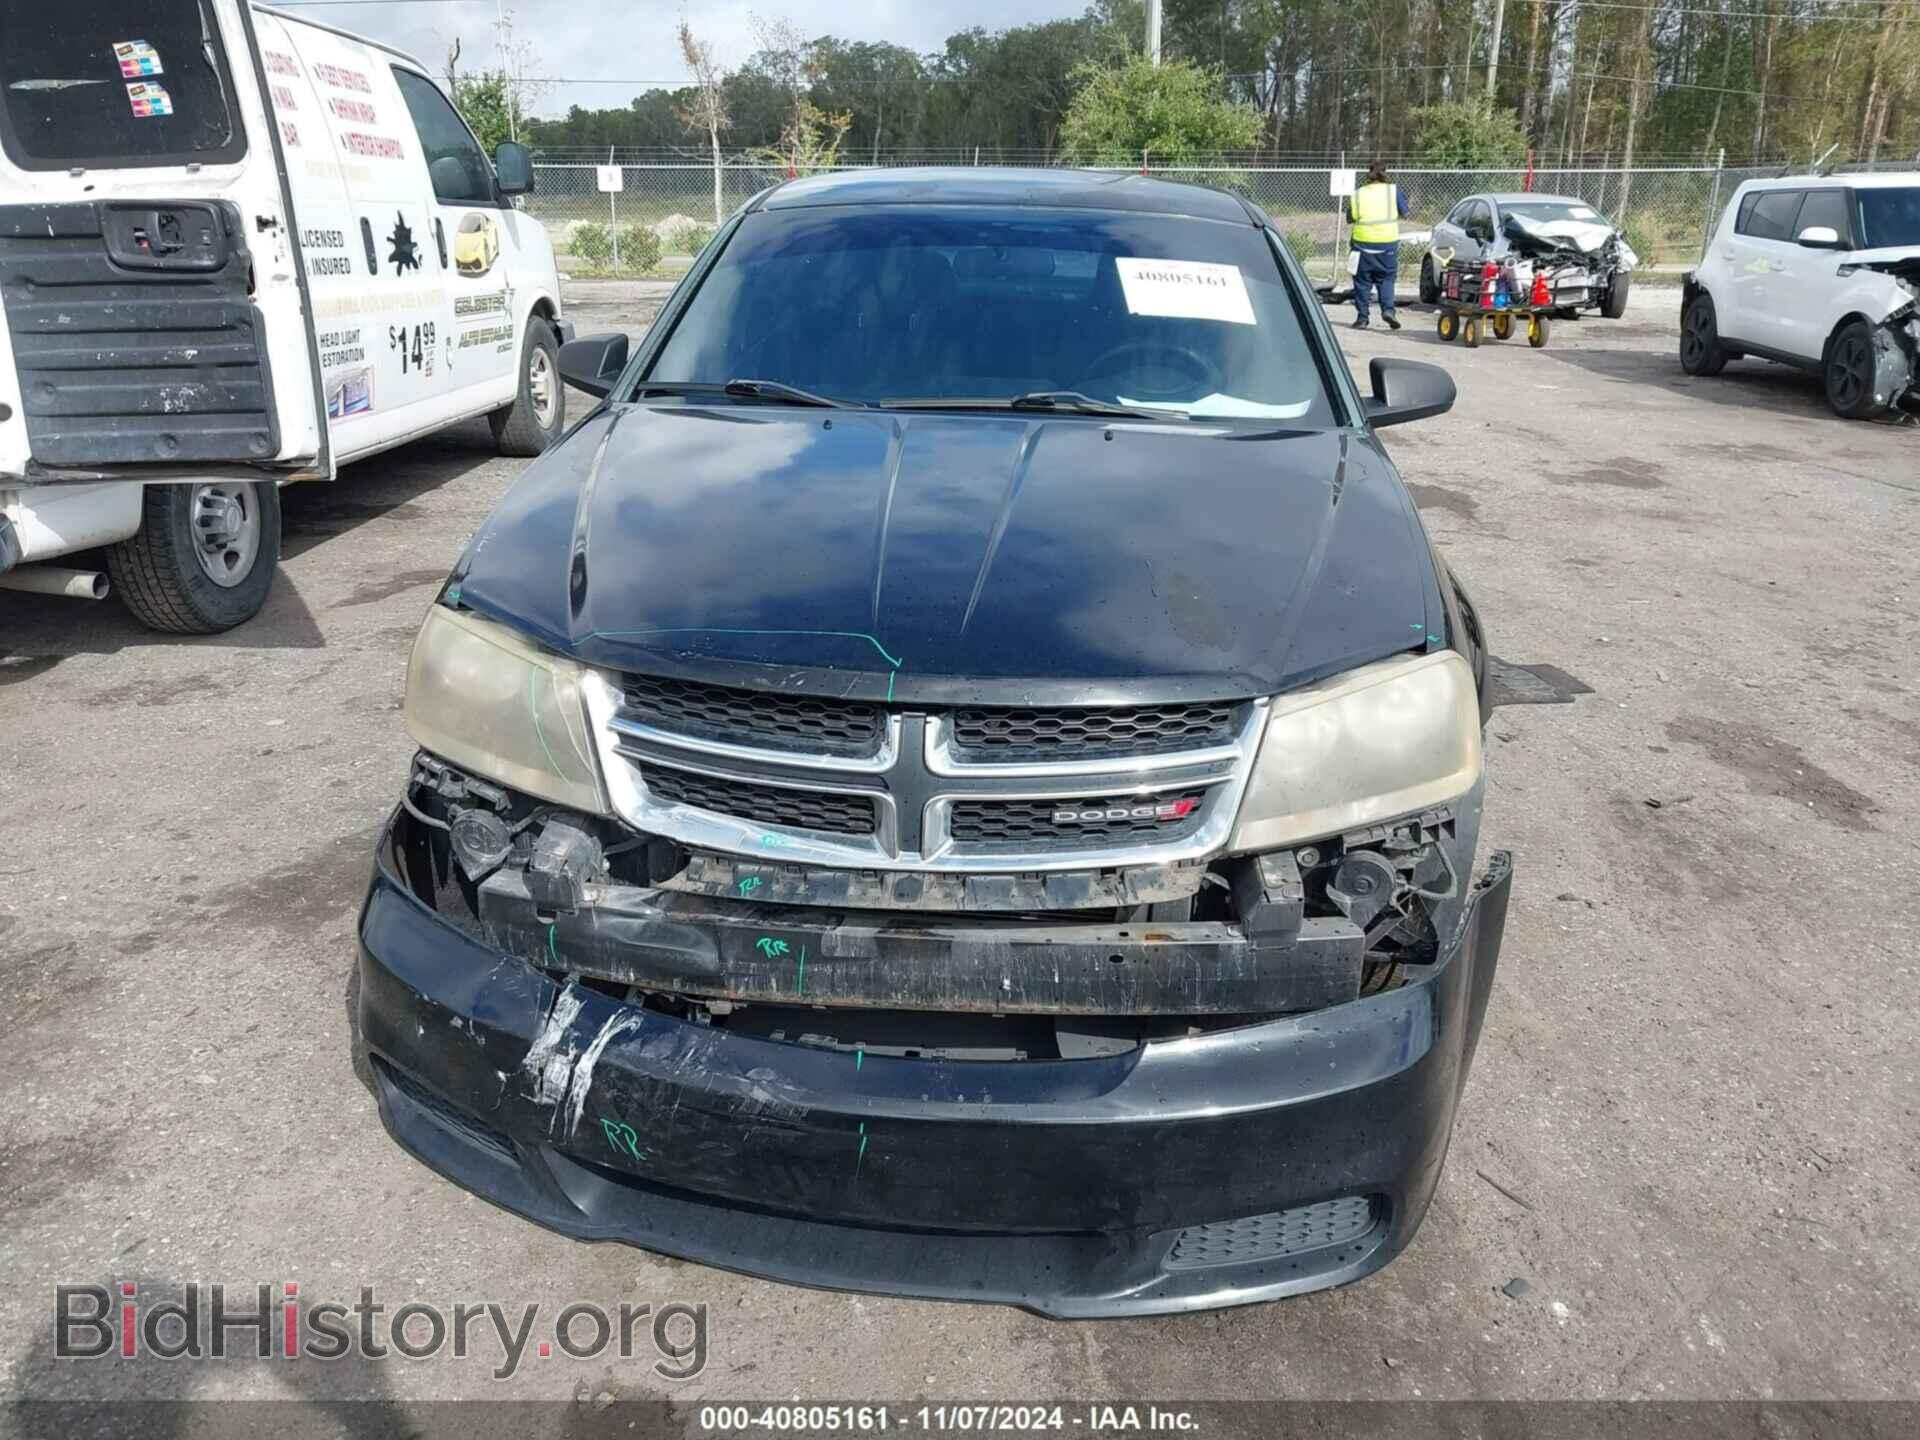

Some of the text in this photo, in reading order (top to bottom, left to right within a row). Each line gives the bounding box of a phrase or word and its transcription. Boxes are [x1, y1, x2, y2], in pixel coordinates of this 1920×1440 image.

[301, 230, 344, 248] LICENSED
[311, 257, 351, 276] INSURED
[1131, 271, 1228, 288] 40805161
[320, 329, 360, 348] HEAD LIGHT
[1053, 804, 1177, 822] DODGE
